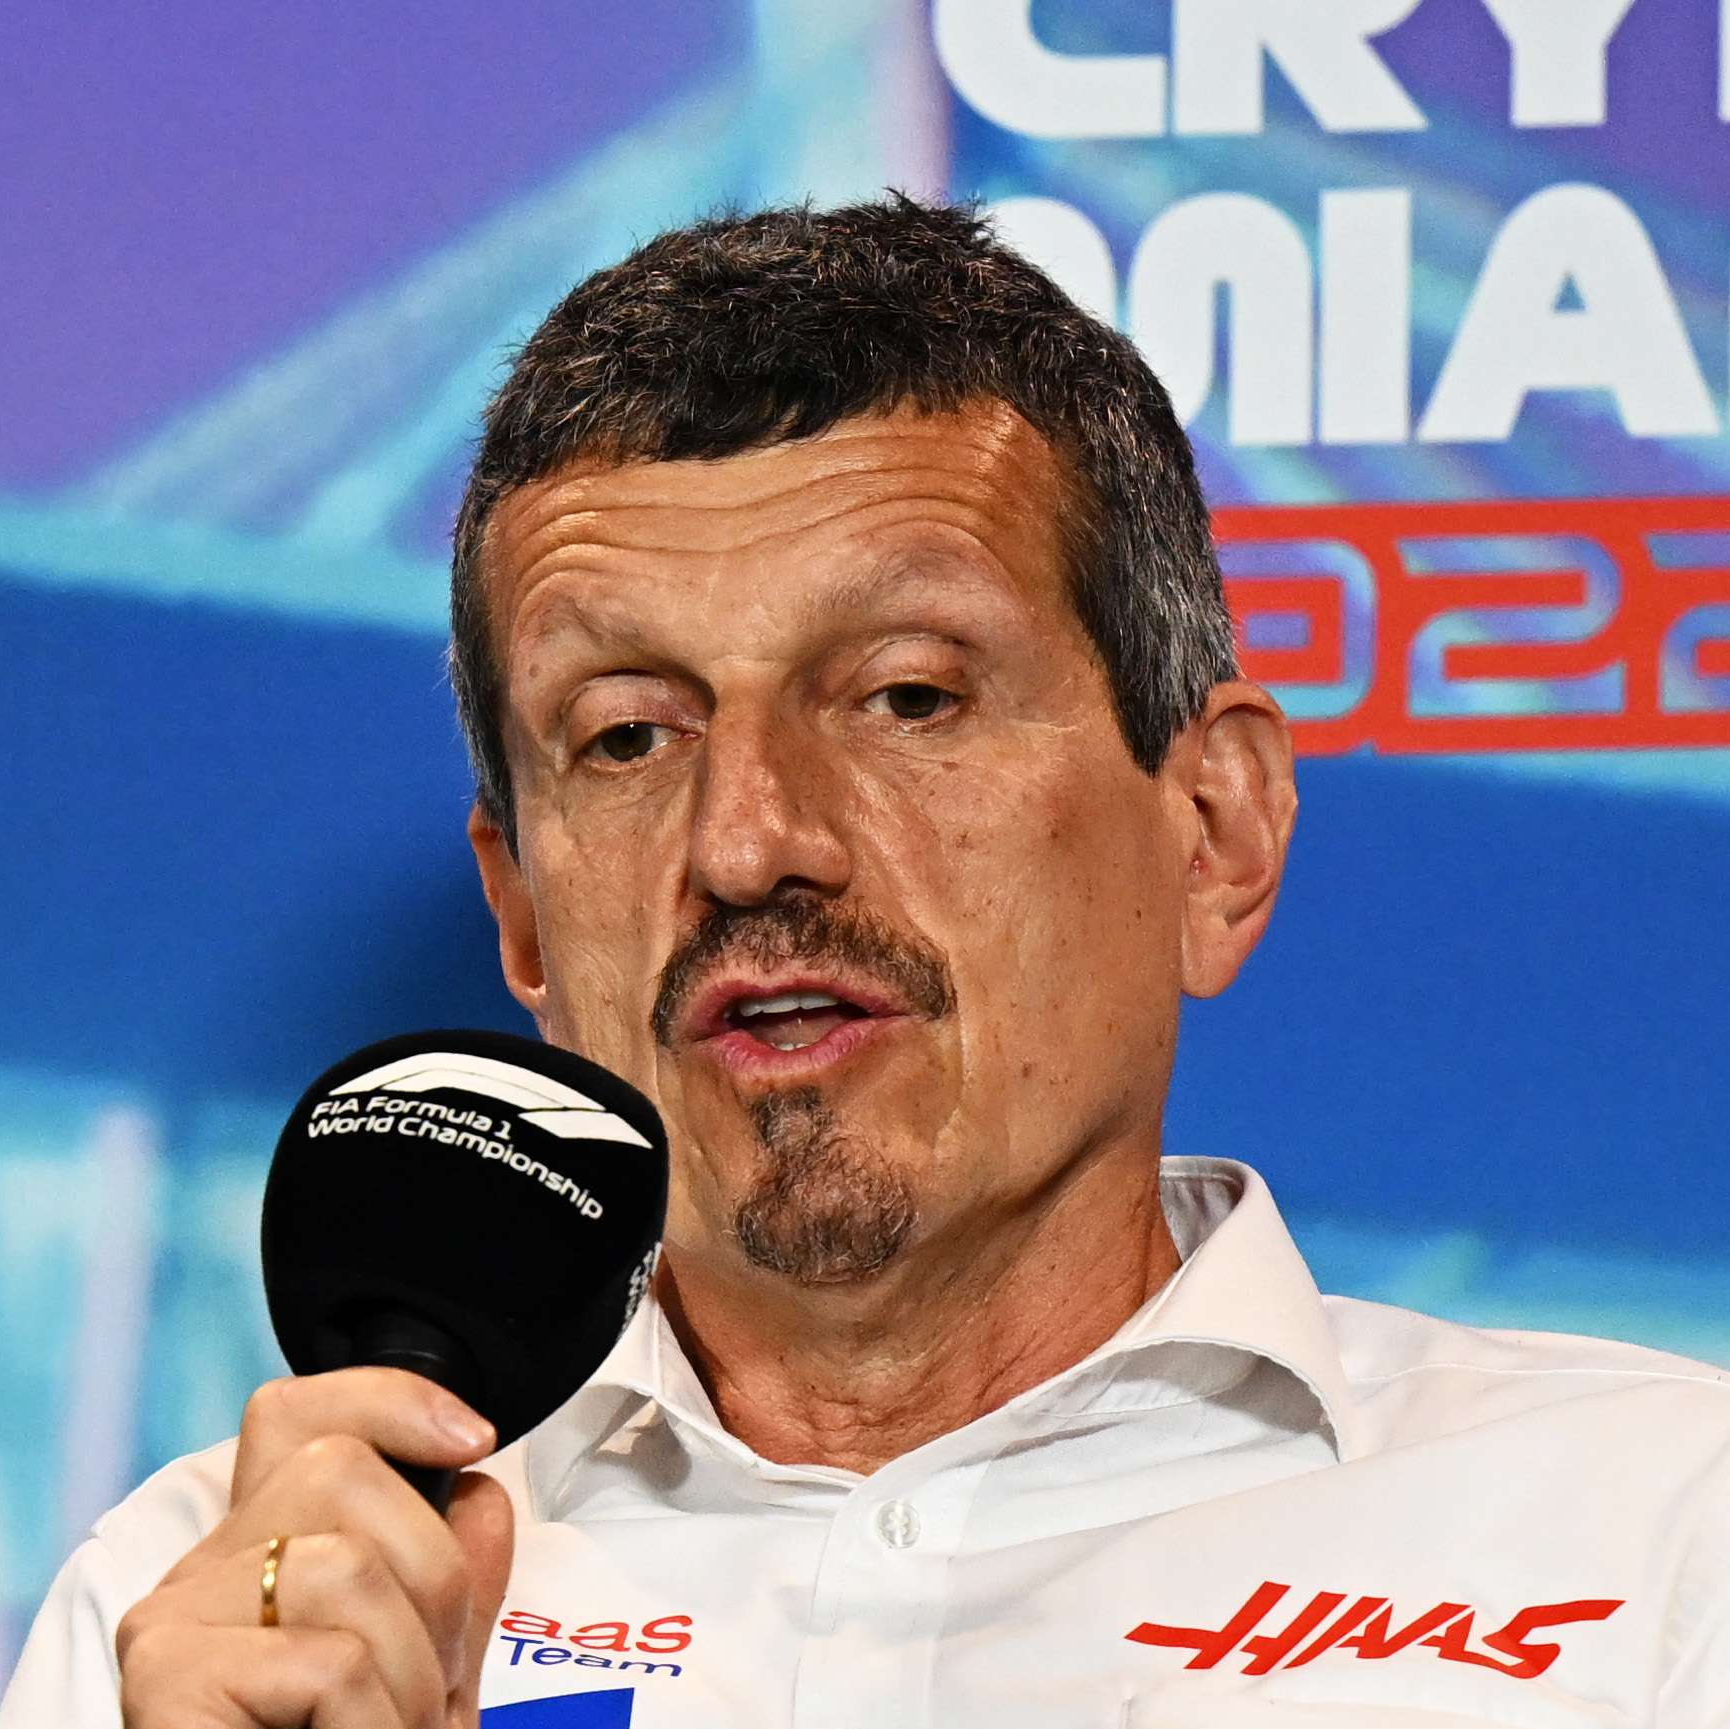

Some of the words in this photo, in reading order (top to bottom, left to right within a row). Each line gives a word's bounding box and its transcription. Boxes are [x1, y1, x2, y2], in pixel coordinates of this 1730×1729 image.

[311, 1097, 359, 1120] FIA
[366, 1096, 491, 1131] Formula
[494, 1119, 512, 1140] 1
[308, 1115, 395, 1138] World
[397, 1116, 604, 1220] Championship
[500, 1635, 683, 1677] Team
[1123, 1580, 1627, 1679] HAAS
